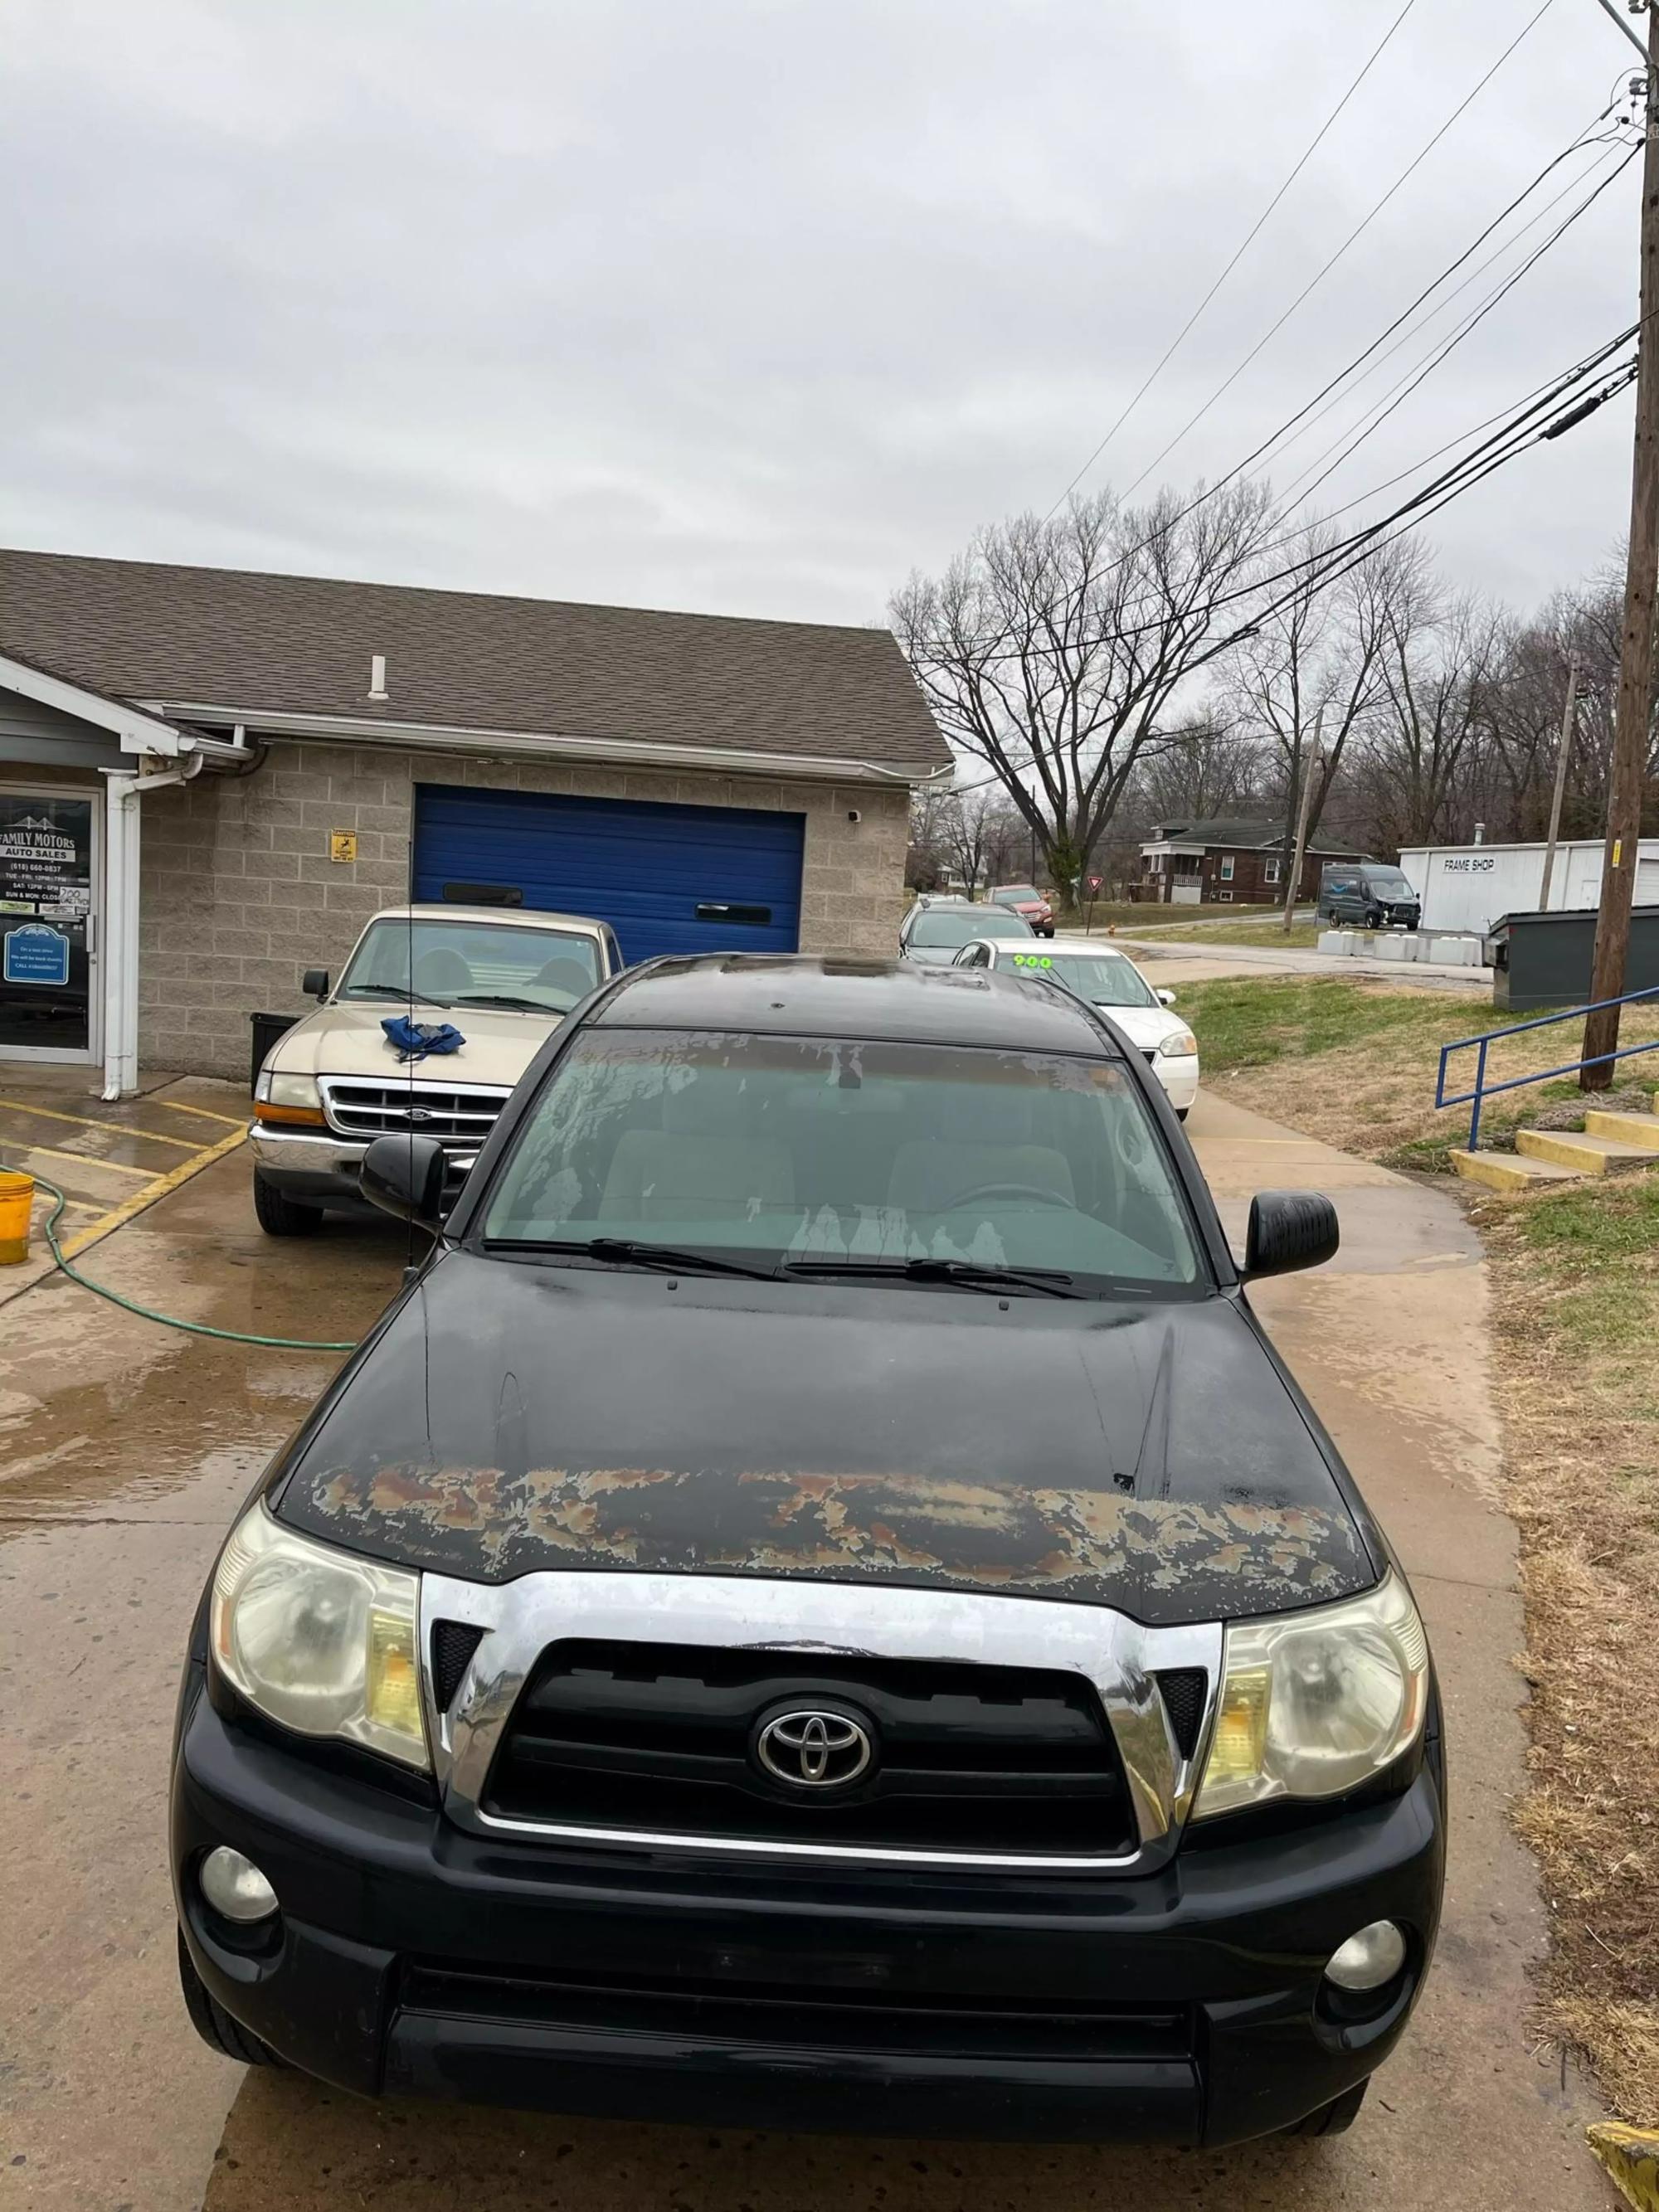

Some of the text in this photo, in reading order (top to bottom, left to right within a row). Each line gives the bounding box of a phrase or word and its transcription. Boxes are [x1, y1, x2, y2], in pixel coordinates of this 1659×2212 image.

[34, 833, 75, 848] MOTORS
[6, 848, 66, 859] AUTO SALES
[1444, 859, 1494, 871] FRAME SHOP
[1014, 955, 1052, 969] 900
